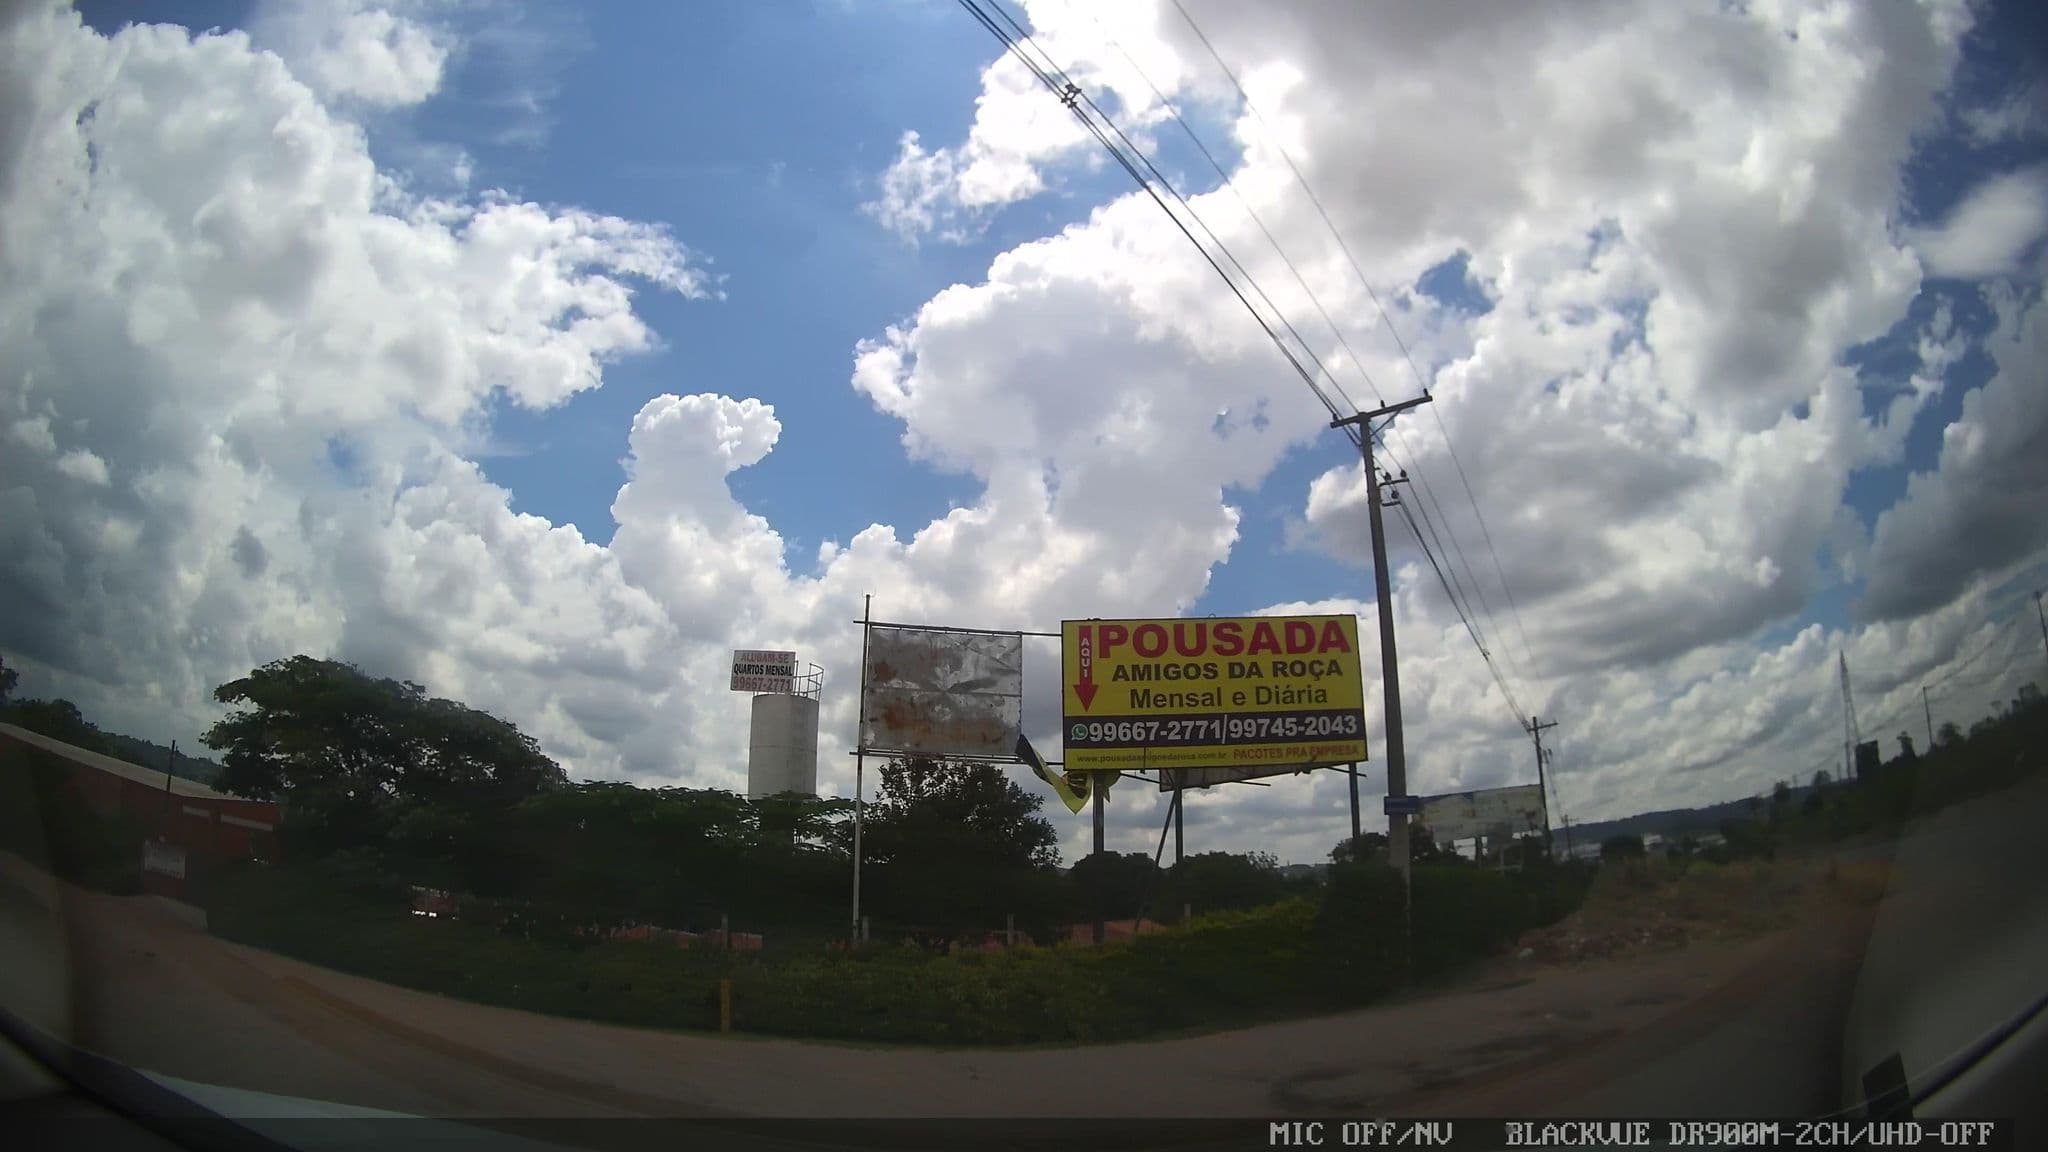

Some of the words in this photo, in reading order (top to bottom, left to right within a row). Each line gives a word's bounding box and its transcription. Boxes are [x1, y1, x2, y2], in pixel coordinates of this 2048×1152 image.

[1099, 620, 1351, 659] POUSADA
[1081, 637, 1090, 678] AQUI
[734, 663, 764, 675] QUARTOS
[765, 665, 792, 677] MENSAL
[1112, 662, 1219, 682] AMIGOS
[1228, 661, 1264, 679] DA
[1272, 659, 1343, 682] ROÇA
[734, 676, 791, 691] 99667-2771
[1130, 687, 1222, 709] Mensal
[1231, 691, 1246, 707] e
[1256, 684, 1328, 706] Diária
[1233, 748, 1283, 760] PACOTES
[1286, 746, 1309, 759] PRA
